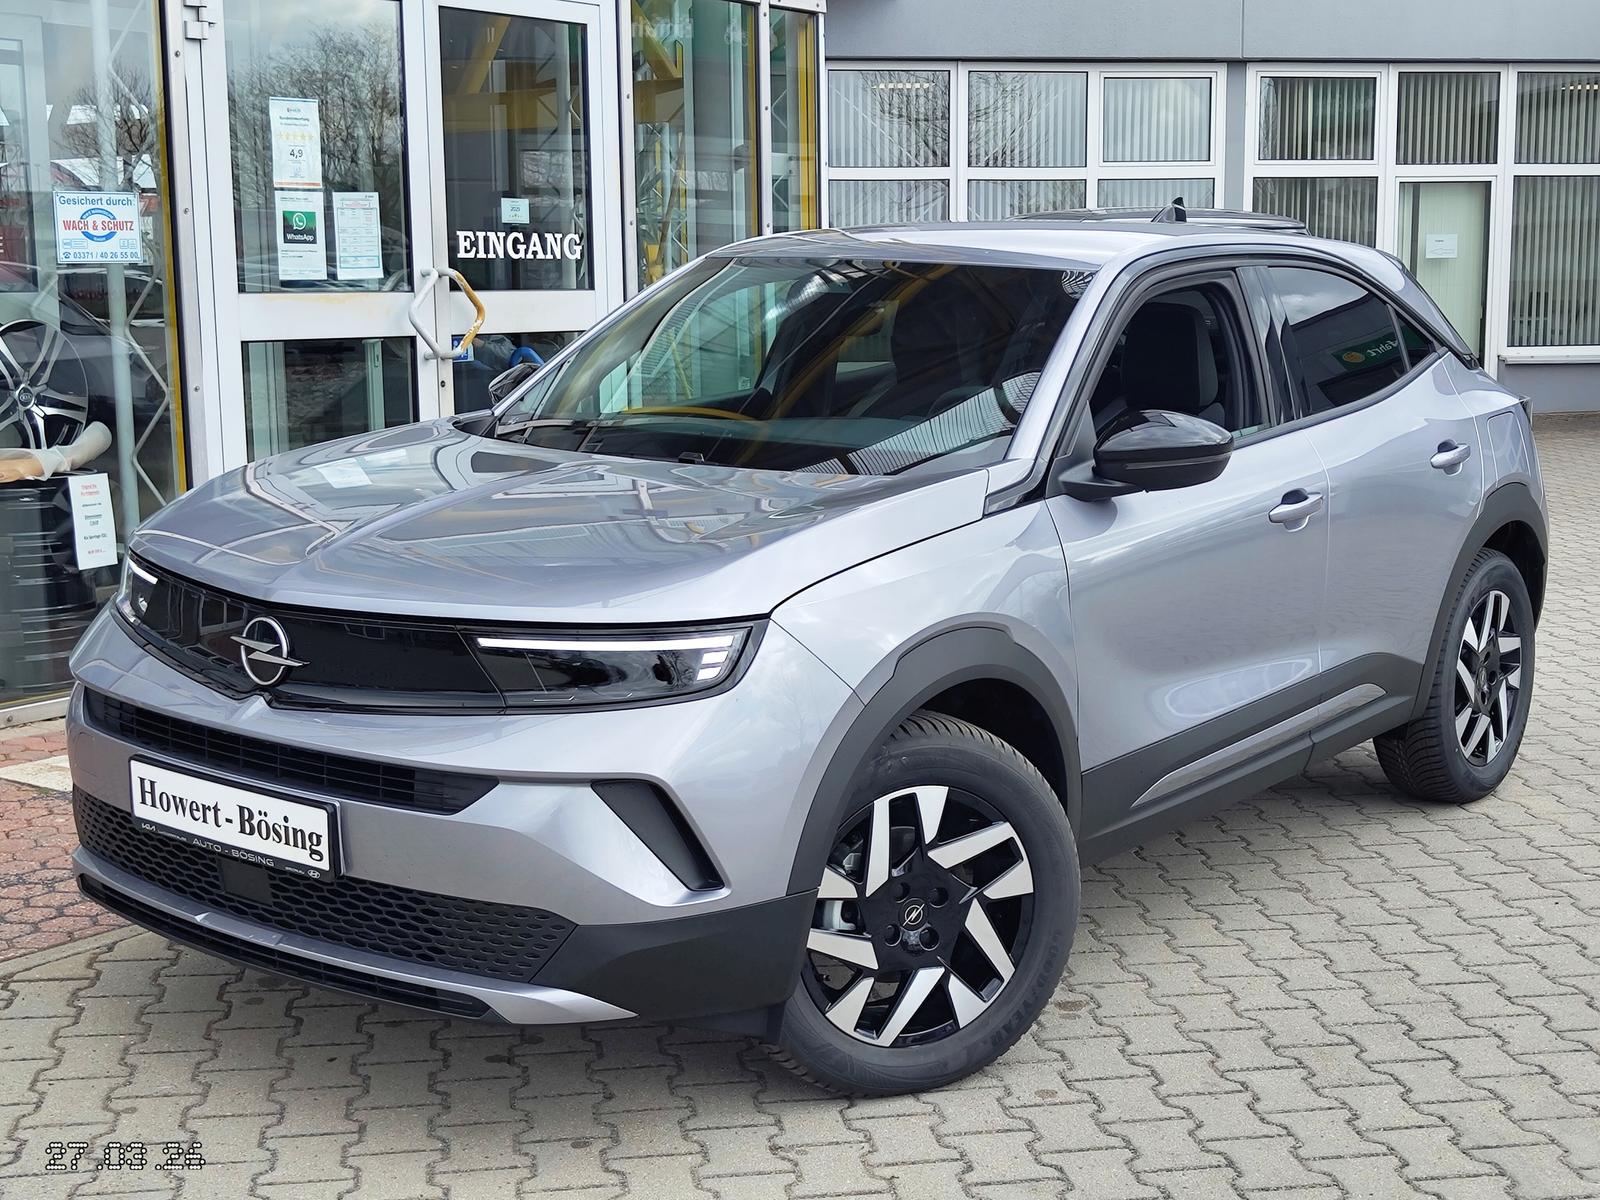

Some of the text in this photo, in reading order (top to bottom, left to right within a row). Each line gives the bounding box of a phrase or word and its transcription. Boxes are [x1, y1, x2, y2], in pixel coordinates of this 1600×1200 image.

[289, 149, 304, 159] 4,9
[58, 195, 104, 206] Gesichert
[62, 219, 134, 231] WACH & SCHUTZ
[286, 233, 315, 242] WhatsApp
[456, 230, 582, 260] EINGANG
[73, 251, 93, 259] 03371
[193, 839, 222, 852] AUTO
[231, 849, 275, 867] BÖSING
